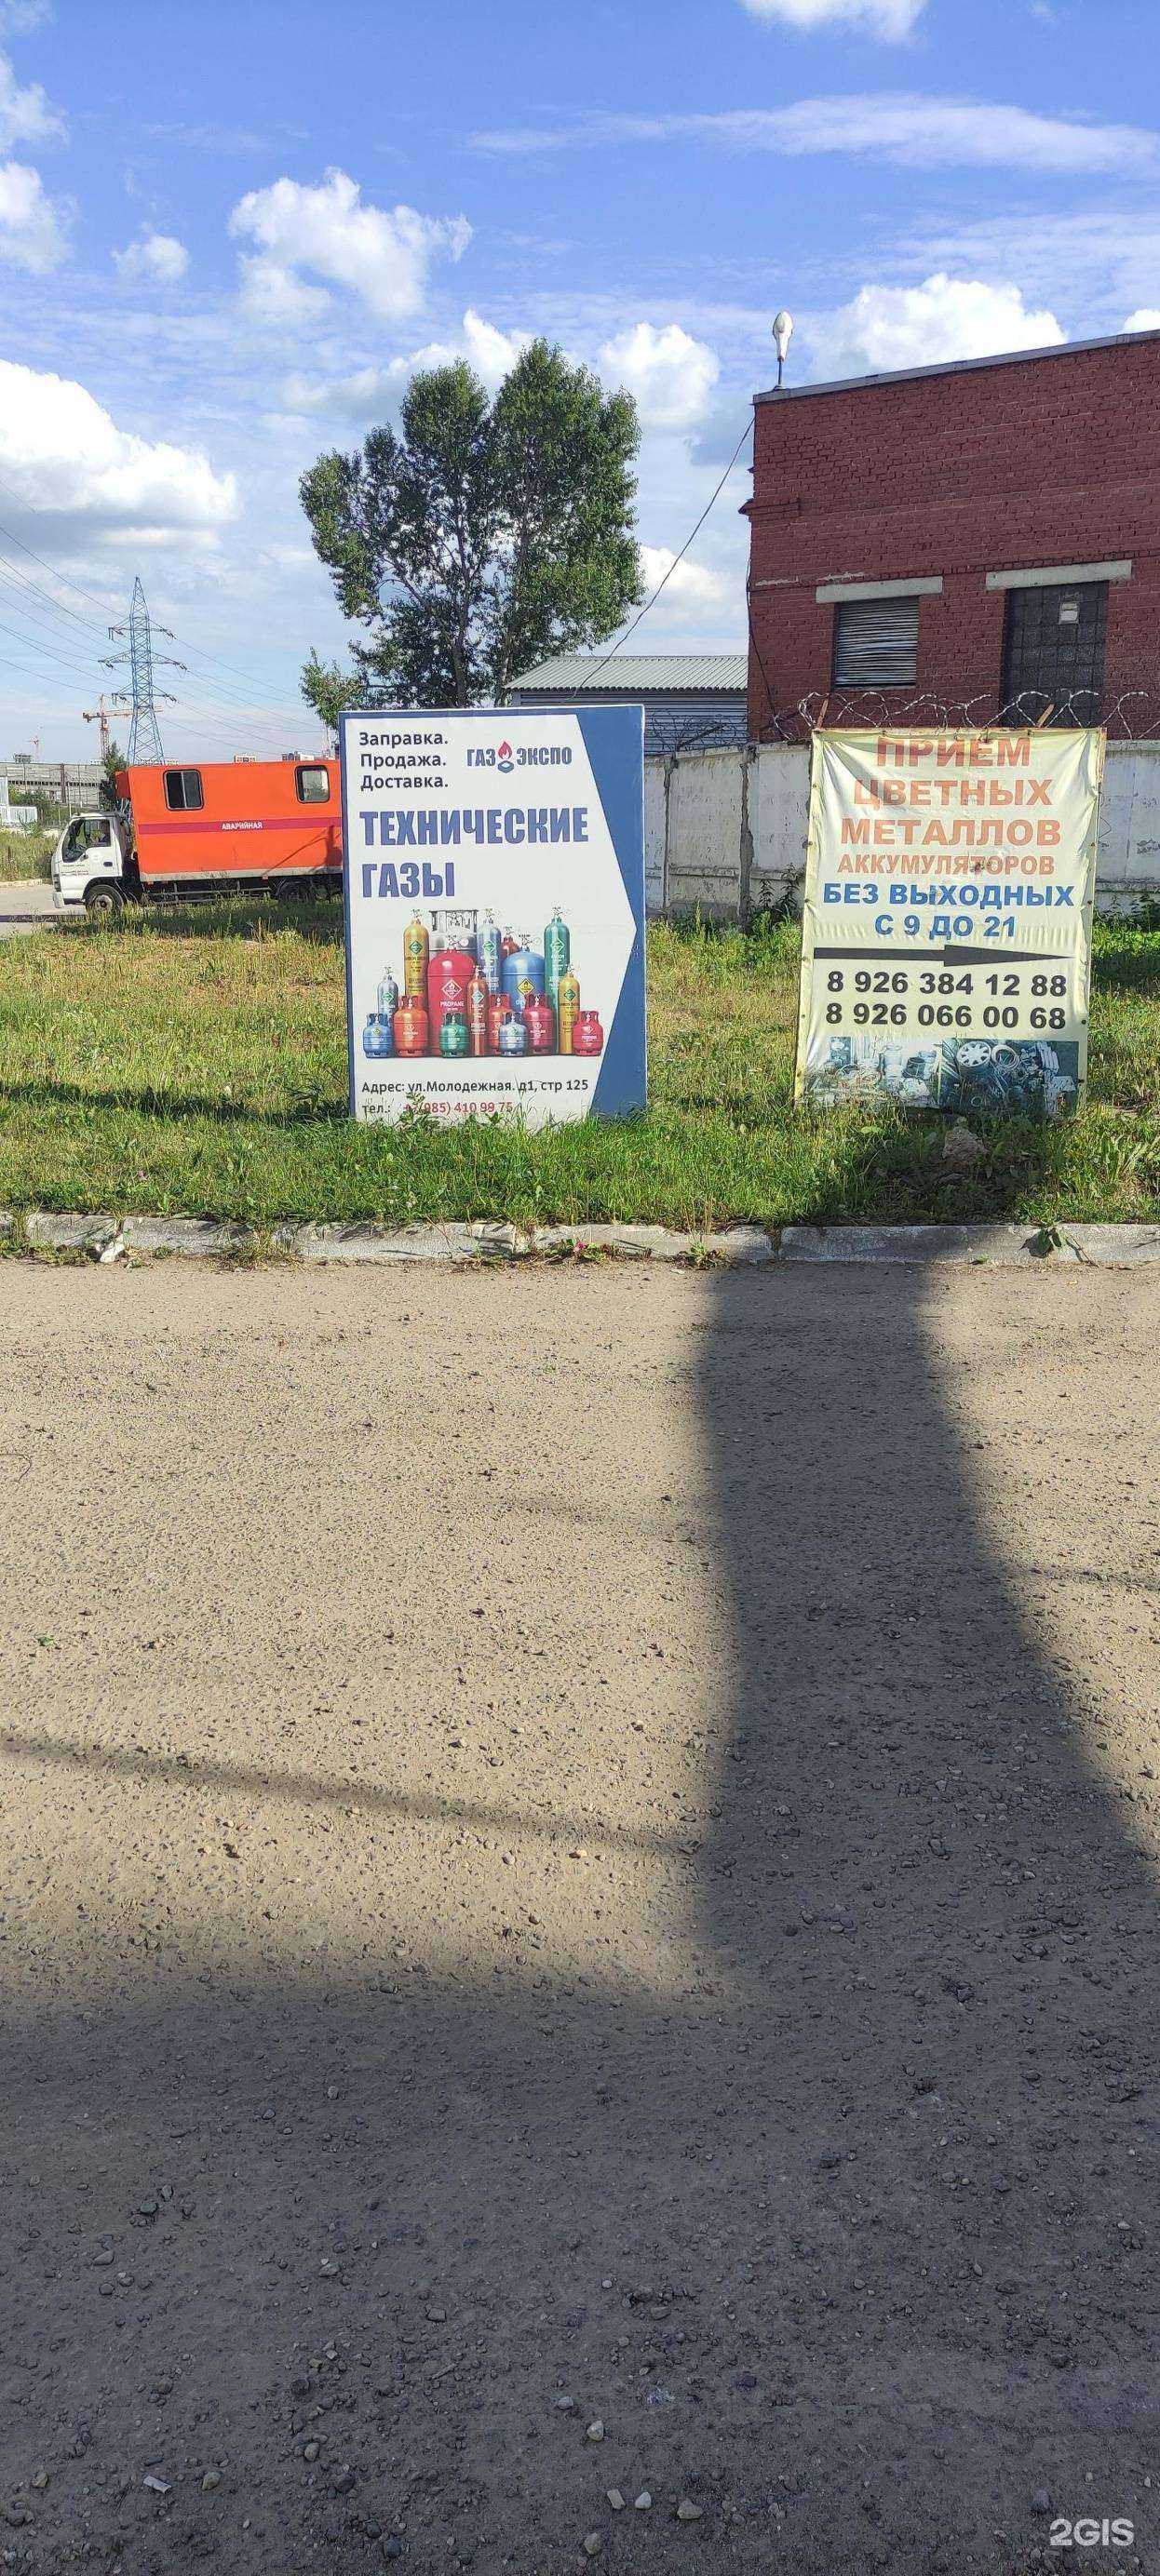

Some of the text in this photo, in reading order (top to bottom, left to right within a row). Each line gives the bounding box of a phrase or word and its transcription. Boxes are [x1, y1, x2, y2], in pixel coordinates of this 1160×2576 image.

[359, 731, 449, 747] Заправка.
[360, 753, 447, 770] Продажа.
[466, 746, 573, 767] ГАЗ ЭКСПО
[877, 737, 1031, 767] ПРИЕМ
[360, 774, 449, 791] Доставка.
[853, 779, 1052, 811] ЦВЕТНЫХ
[359, 807, 588, 846] ТЕХНИЧЕСКИЕ
[841, 818, 1060, 846] МЕТАЛЛОВ
[837, 853, 1055, 876] АККУМУЛЯТОРОВ
[361, 862, 455, 898] ГАЗЫ
[823, 883, 1074, 910] БЕЗ ВЫХОДНЫХ
[875, 915, 1016, 940] С 9 ДО 21
[827, 971, 1067, 997] 8 926 384 12 88
[826, 1002, 1066, 1029] 8 926 066 00 68
[362, 1081, 405, 1094] Адрес:
[541, 1082, 562, 1093] стр
[566, 1080, 588, 1090] 125
[362, 1104, 390, 1114] тел.:
[453, 1102, 477, 1113] 410
[479, 1102, 494, 1112] 99
[498, 1101, 513, 1112] 75
